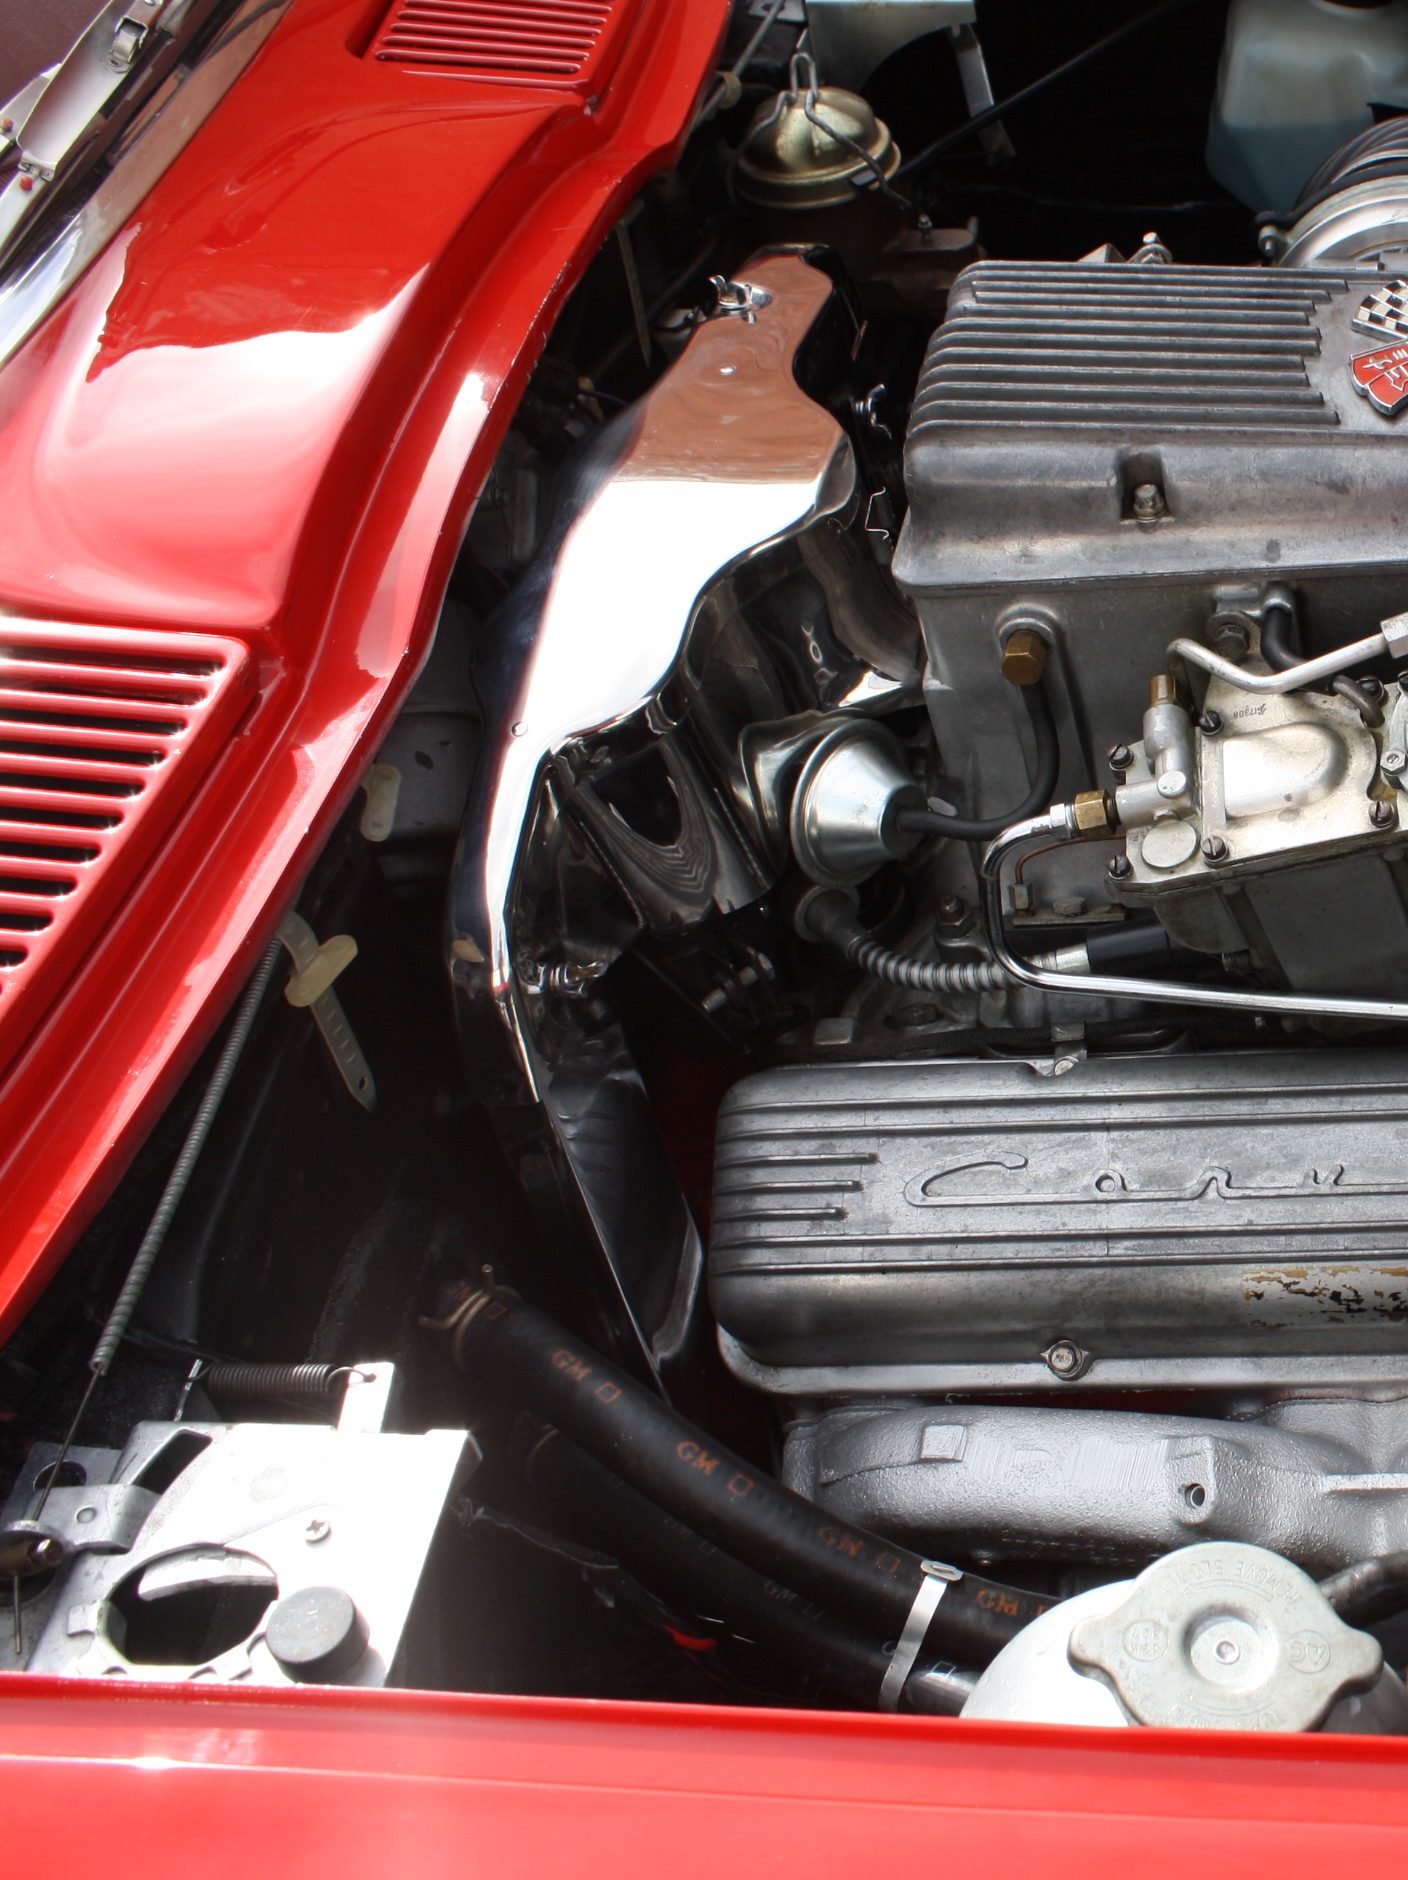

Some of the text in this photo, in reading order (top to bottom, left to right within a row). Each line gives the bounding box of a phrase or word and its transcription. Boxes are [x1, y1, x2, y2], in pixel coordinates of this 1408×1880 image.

[551, 1349, 589, 1381] GM
[676, 1440, 720, 1476] GM
[819, 1525, 865, 1557] GM
[974, 1588, 1020, 1618] GM
